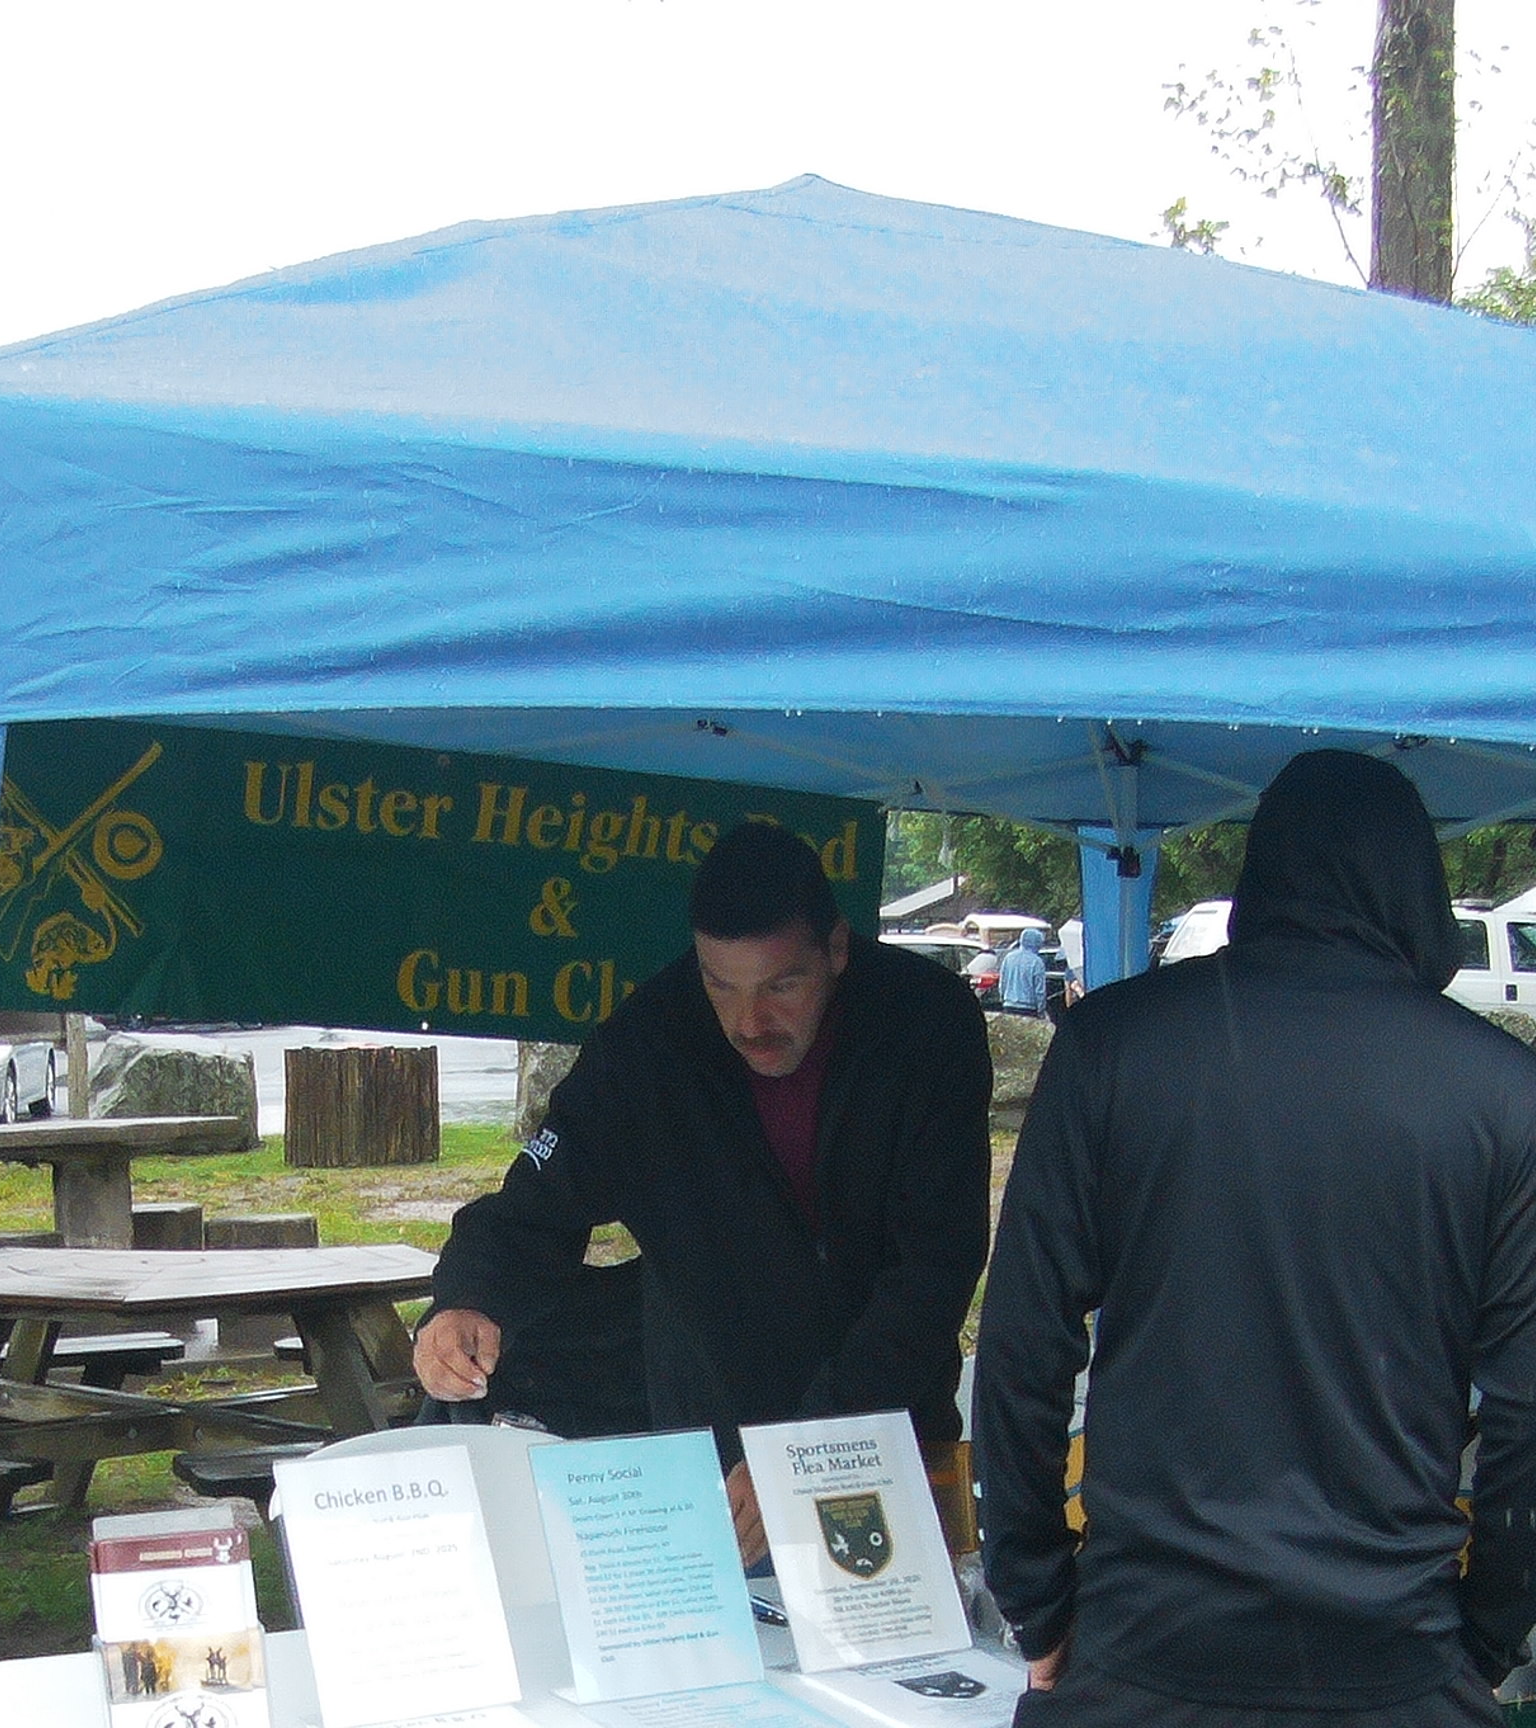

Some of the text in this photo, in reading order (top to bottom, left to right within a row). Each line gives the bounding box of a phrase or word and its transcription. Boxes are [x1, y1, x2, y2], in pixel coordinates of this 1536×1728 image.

[243, 760, 454, 840] Ulster
[472, 781, 719, 874] Heights
[529, 877, 579, 939] &
[396, 949, 635, 1024] Gun Cl
[786, 1439, 878, 1460] Sportsmens
[792, 1454, 883, 1475] Flea Market
[567, 1465, 643, 1484] Penny Social
[314, 1479, 449, 1510] Chicken B.B.Q.
